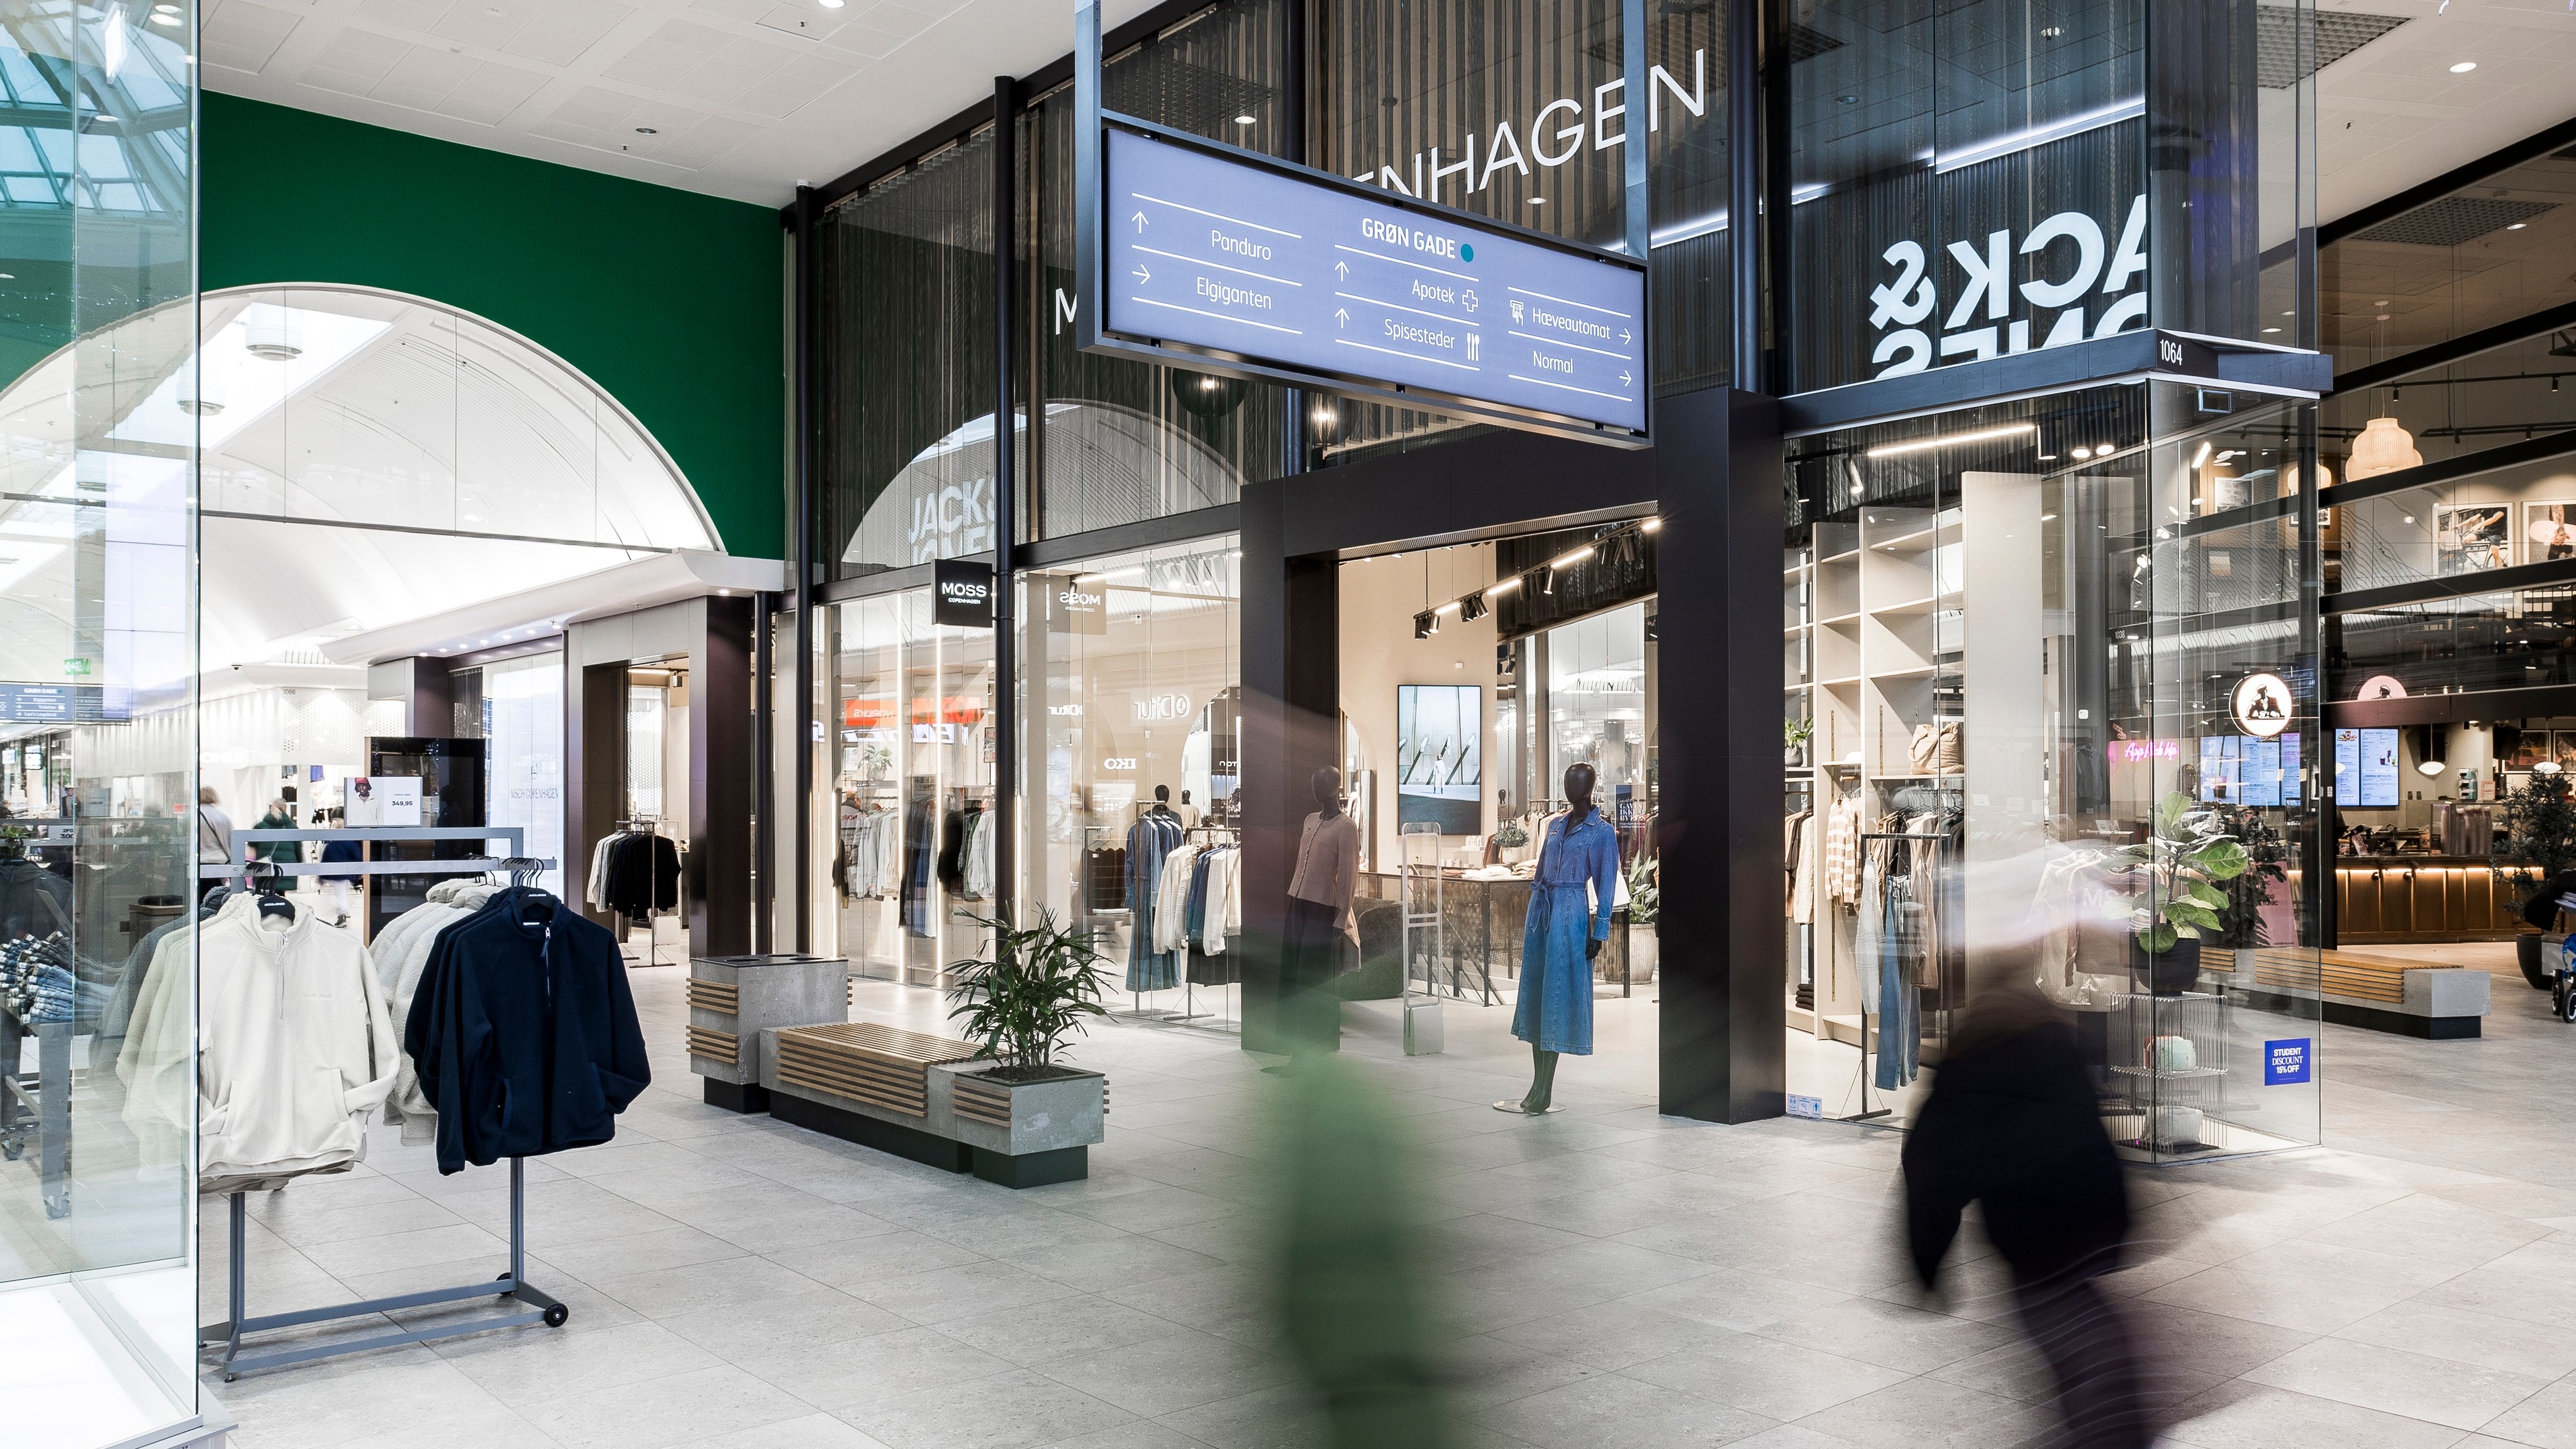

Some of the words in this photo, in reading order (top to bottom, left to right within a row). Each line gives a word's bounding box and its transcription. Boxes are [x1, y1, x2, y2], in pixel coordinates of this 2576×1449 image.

[1353, 48, 1704, 203] NHAGEN
[1211, 228, 1272, 262] Panduro
[1362, 217, 1409, 247] GRØN
[1414, 230, 1456, 259] GADE
[1196, 275, 1272, 310] Elgiganten
[1412, 279, 1455, 306] Apotek
[1384, 318, 1455, 351] Spisesteder
[1533, 307, 1611, 341] Hæveautomat
[1533, 350, 1574, 375] Normal
[2159, 338, 2183, 366] 1064
[909, 478, 985, 545] JACK
[941, 582, 987, 597] MOSS
[948, 597, 981, 605] COPENHAGEN
[2115, 630, 2125, 639] 1038
[526, 787, 559, 799] COPENHAGEN
[2272, 1056, 2303, 1066] DISCOUNT
[2273, 1047, 2302, 1057] STUDENT
[2276, 1065, 2287, 1074] 15%
[2287, 1065, 2300, 1074] OFF
